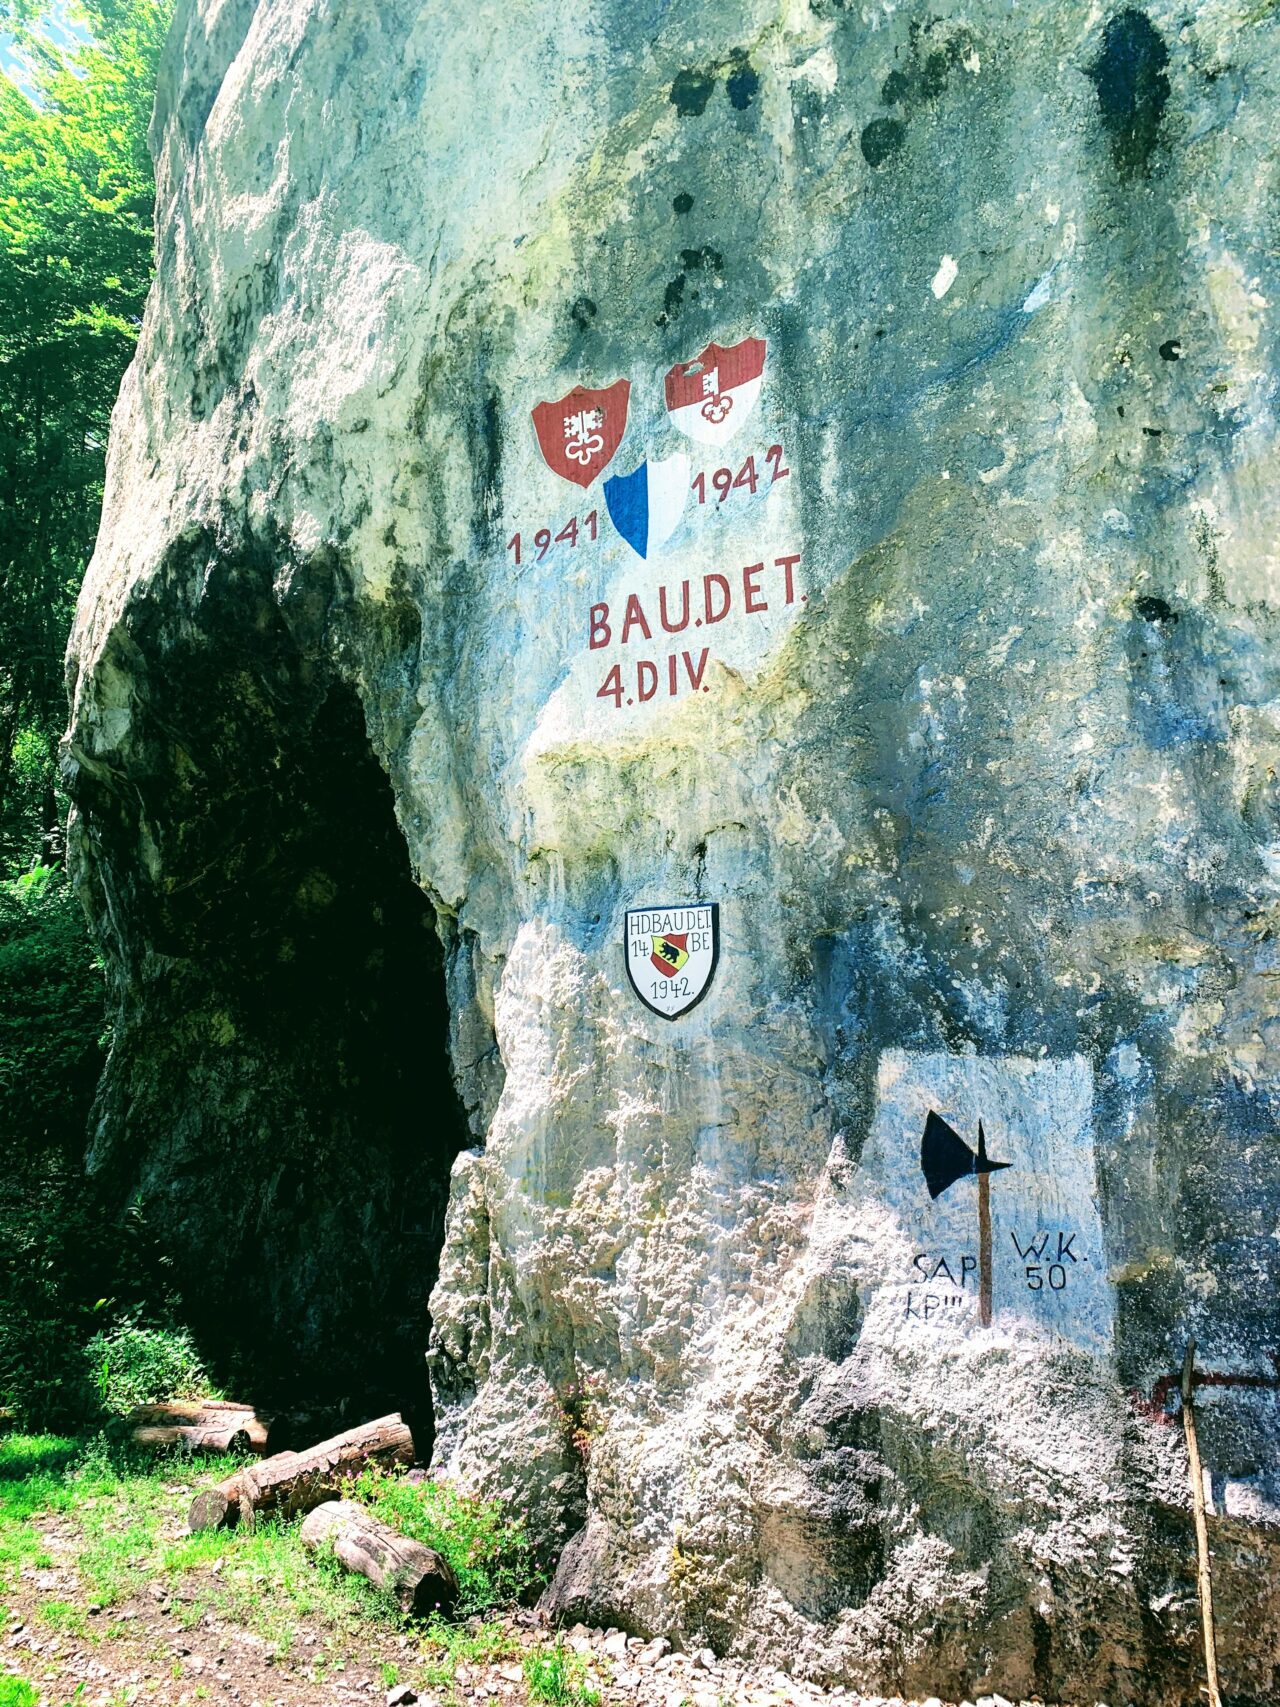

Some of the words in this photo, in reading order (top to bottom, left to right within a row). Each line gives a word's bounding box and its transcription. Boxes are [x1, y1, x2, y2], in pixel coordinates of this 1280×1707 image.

[691, 445, 790, 504] 1942
[507, 511, 598, 565] 1941
[691, 932, 710, 952] BE
[1011, 1232, 1088, 1263] W.K.
[913, 1253, 977, 1288] SAP
[1026, 1265, 1067, 1291] 50
